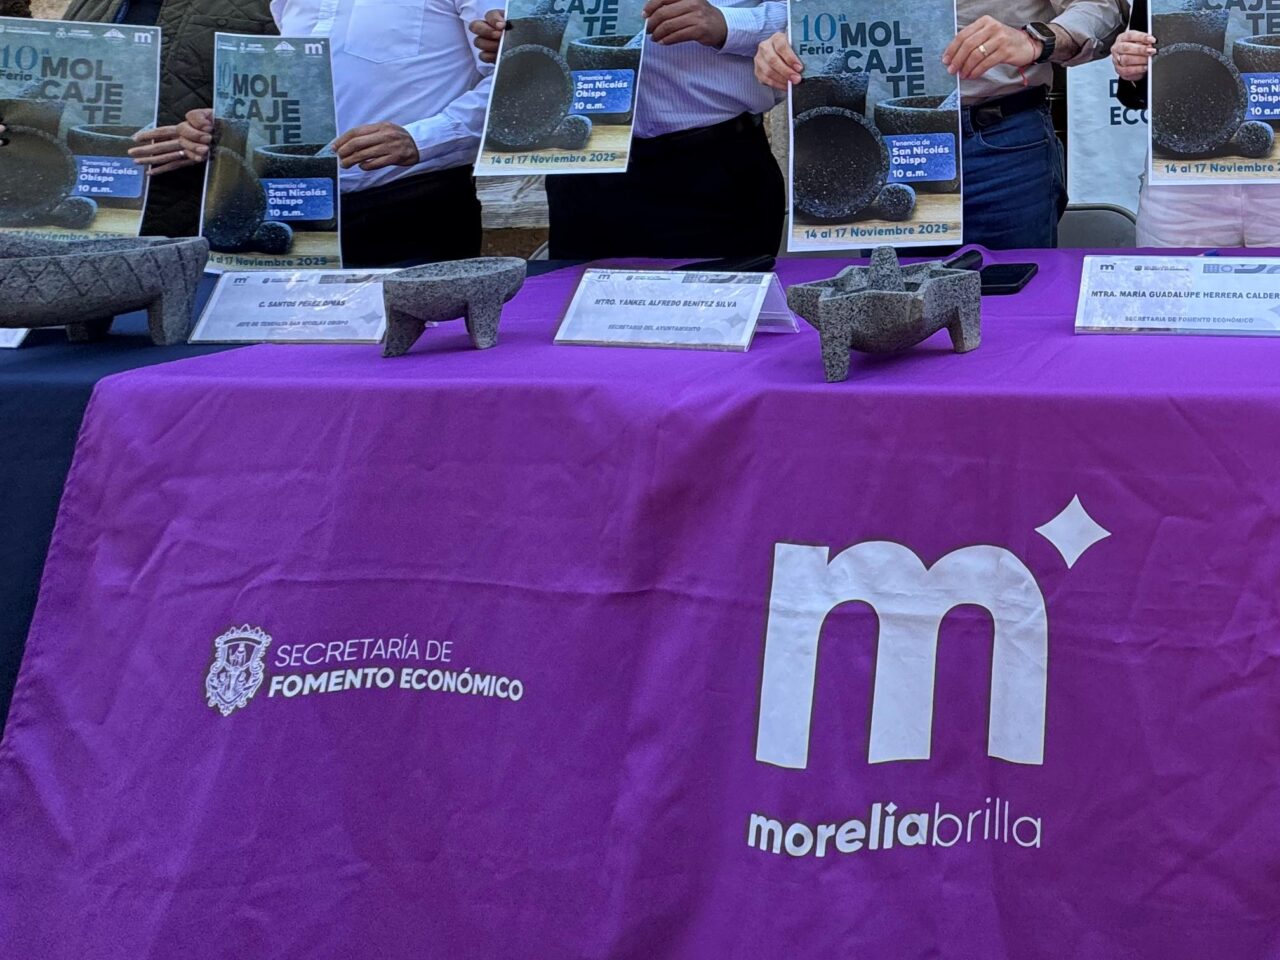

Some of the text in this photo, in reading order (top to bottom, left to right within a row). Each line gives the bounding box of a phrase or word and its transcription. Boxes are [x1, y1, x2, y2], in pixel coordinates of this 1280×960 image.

[583, 16, 618, 36] TE
[841, 20, 911, 48] MOL
[800, 43, 834, 55] Feria
[41, 56, 113, 81] MOL
[844, 47, 924, 74] CAJE
[40, 80, 124, 105] CAJE
[233, 73, 288, 98] MOL
[886, 74, 925, 98] TE
[1250, 85, 1270, 93] San
[576, 91, 606, 99] Obispo
[233, 98, 300, 123] CAJE
[1251, 107, 1262, 115] 10
[505, 156, 513, 164] al
[517, 156, 528, 164] 17
[531, 155, 586, 164] Noviembre
[590, 153, 616, 162] 2025
[892, 145, 949, 155] San Nicolás
[892, 156, 927, 165] Obispo
[1165, 165, 1177, 174] 14
[1181, 164, 1191, 173] al
[1195, 164, 1207, 173] 17
[1210, 163, 1274, 173] Noviembre
[893, 169, 904, 177] 10
[269, 198, 303, 206] Obispo
[805, 224, 948, 239] 14 al 17 Noviembre 2025
[275, 634, 453, 665] SECRETARÍA DE
[755, 540, 1048, 770] m
[269, 664, 523, 702] FOMENTO ECONÓMICO
